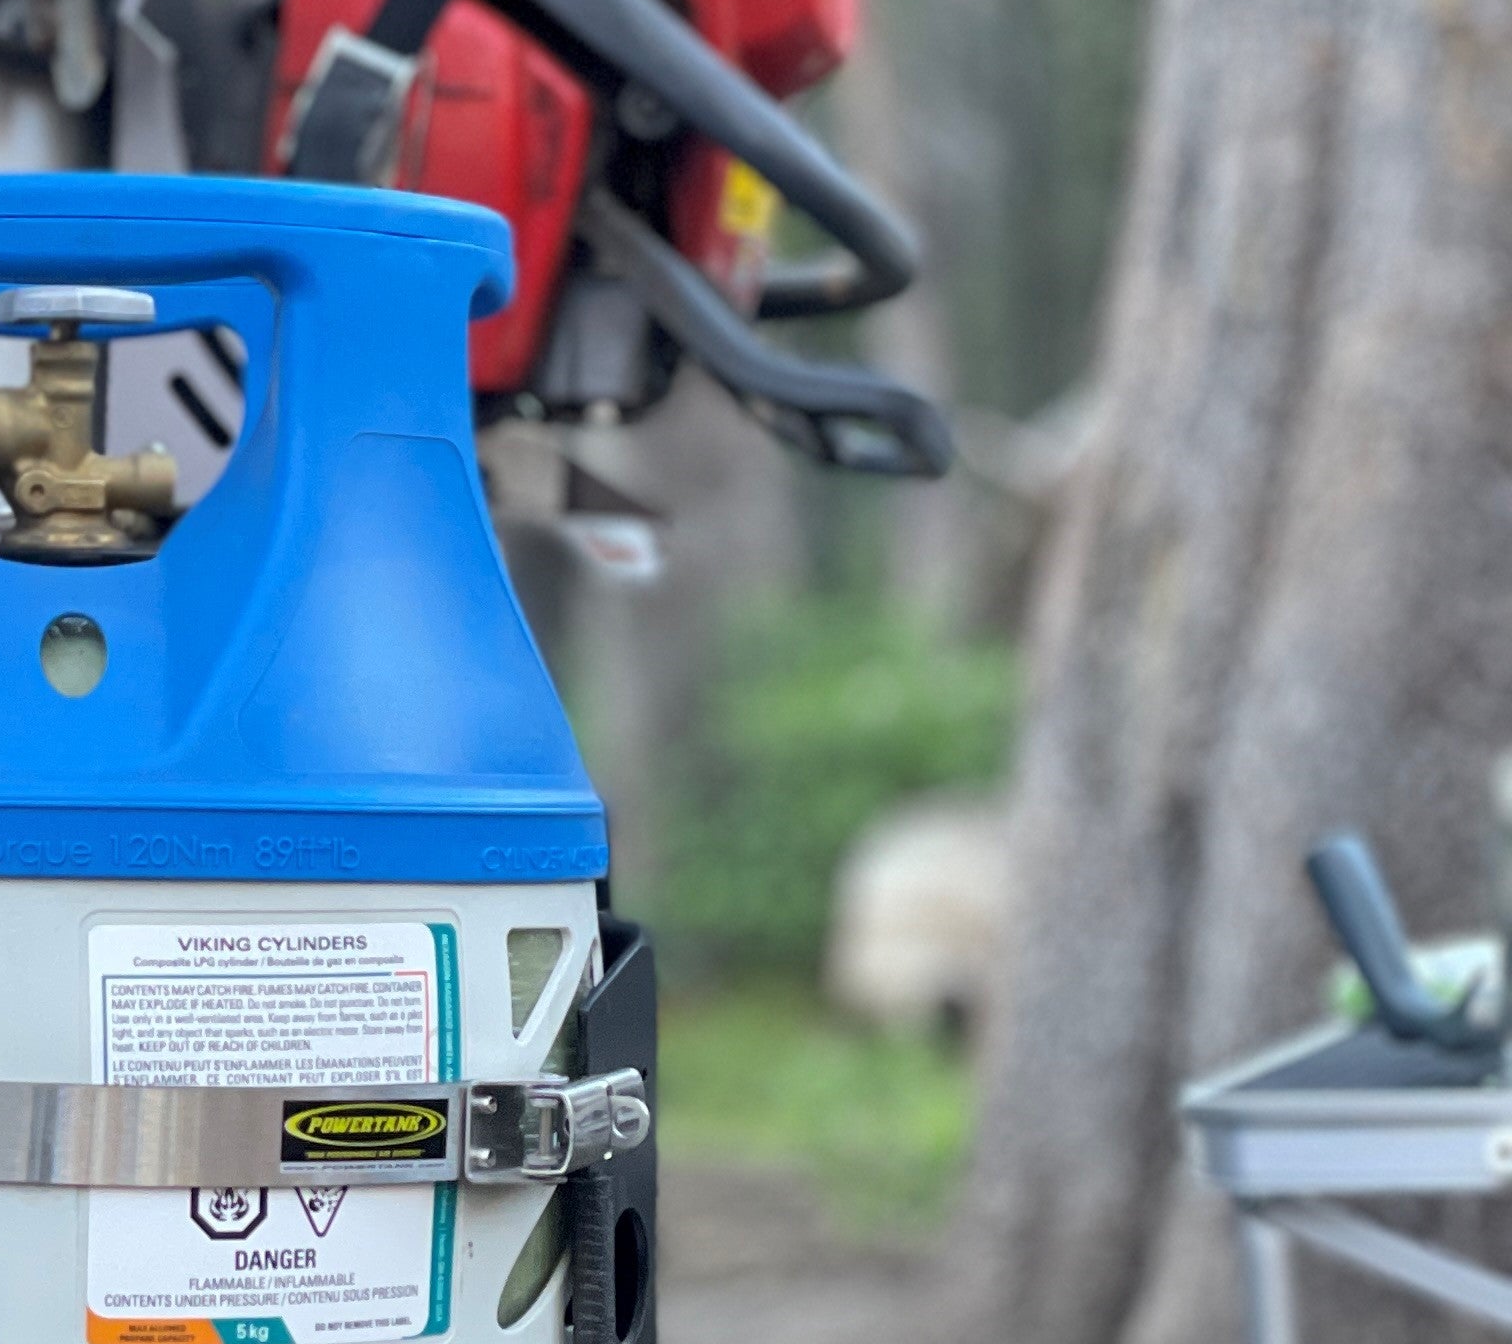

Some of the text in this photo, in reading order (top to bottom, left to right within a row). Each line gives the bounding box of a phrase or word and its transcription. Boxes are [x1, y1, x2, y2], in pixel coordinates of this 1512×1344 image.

[109, 833, 234, 868] 120Nm
[177, 935, 368, 952] VIKING CYLINDERS
[133, 956, 191, 968] Composite
[193, 956, 216, 967] LPG
[111, 985, 170, 996] CONTENTS
[171, 985, 195, 996] MAY
[196, 985, 231, 996] CATCH
[294, 984, 316, 994] MAY
[317, 983, 349, 994] CATCH
[112, 999, 136, 1010] MAY
[139, 999, 187, 1010] EXPLODE
[139, 1041, 167, 1052] KEEP
[168, 1041, 191, 1052] OUT
[208, 1041, 244, 1051] REACH
[112, 1060, 126, 1072] LE
[127, 1060, 182, 1072] CONTENU
[183, 1060, 212, 1071] PEUT
[295, 1058, 313, 1070] LES
[206, 1074, 220, 1085] CE
[226, 1072, 293, 1085] CONTENANT
[299, 1071, 326, 1083] PEUT
[306, 1115, 424, 1134] POWERTANK
[234, 1248, 317, 1271] DANGER
[189, 1276, 266, 1291] FLAMMABLE
[274, 1272, 356, 1289] INFLAMMABLE
[104, 1294, 172, 1307] CONTENTS
[174, 1294, 217, 1307] UNDER
[219, 1292, 280, 1307] PRESSURE
[288, 1290, 341, 1305] CONTENU
[342, 1288, 370, 1303] SOUS
[372, 1284, 419, 1300] PRESSION
[236, 1323, 269, 1343] 5 kg
[327, 1322, 343, 1331] NOT
